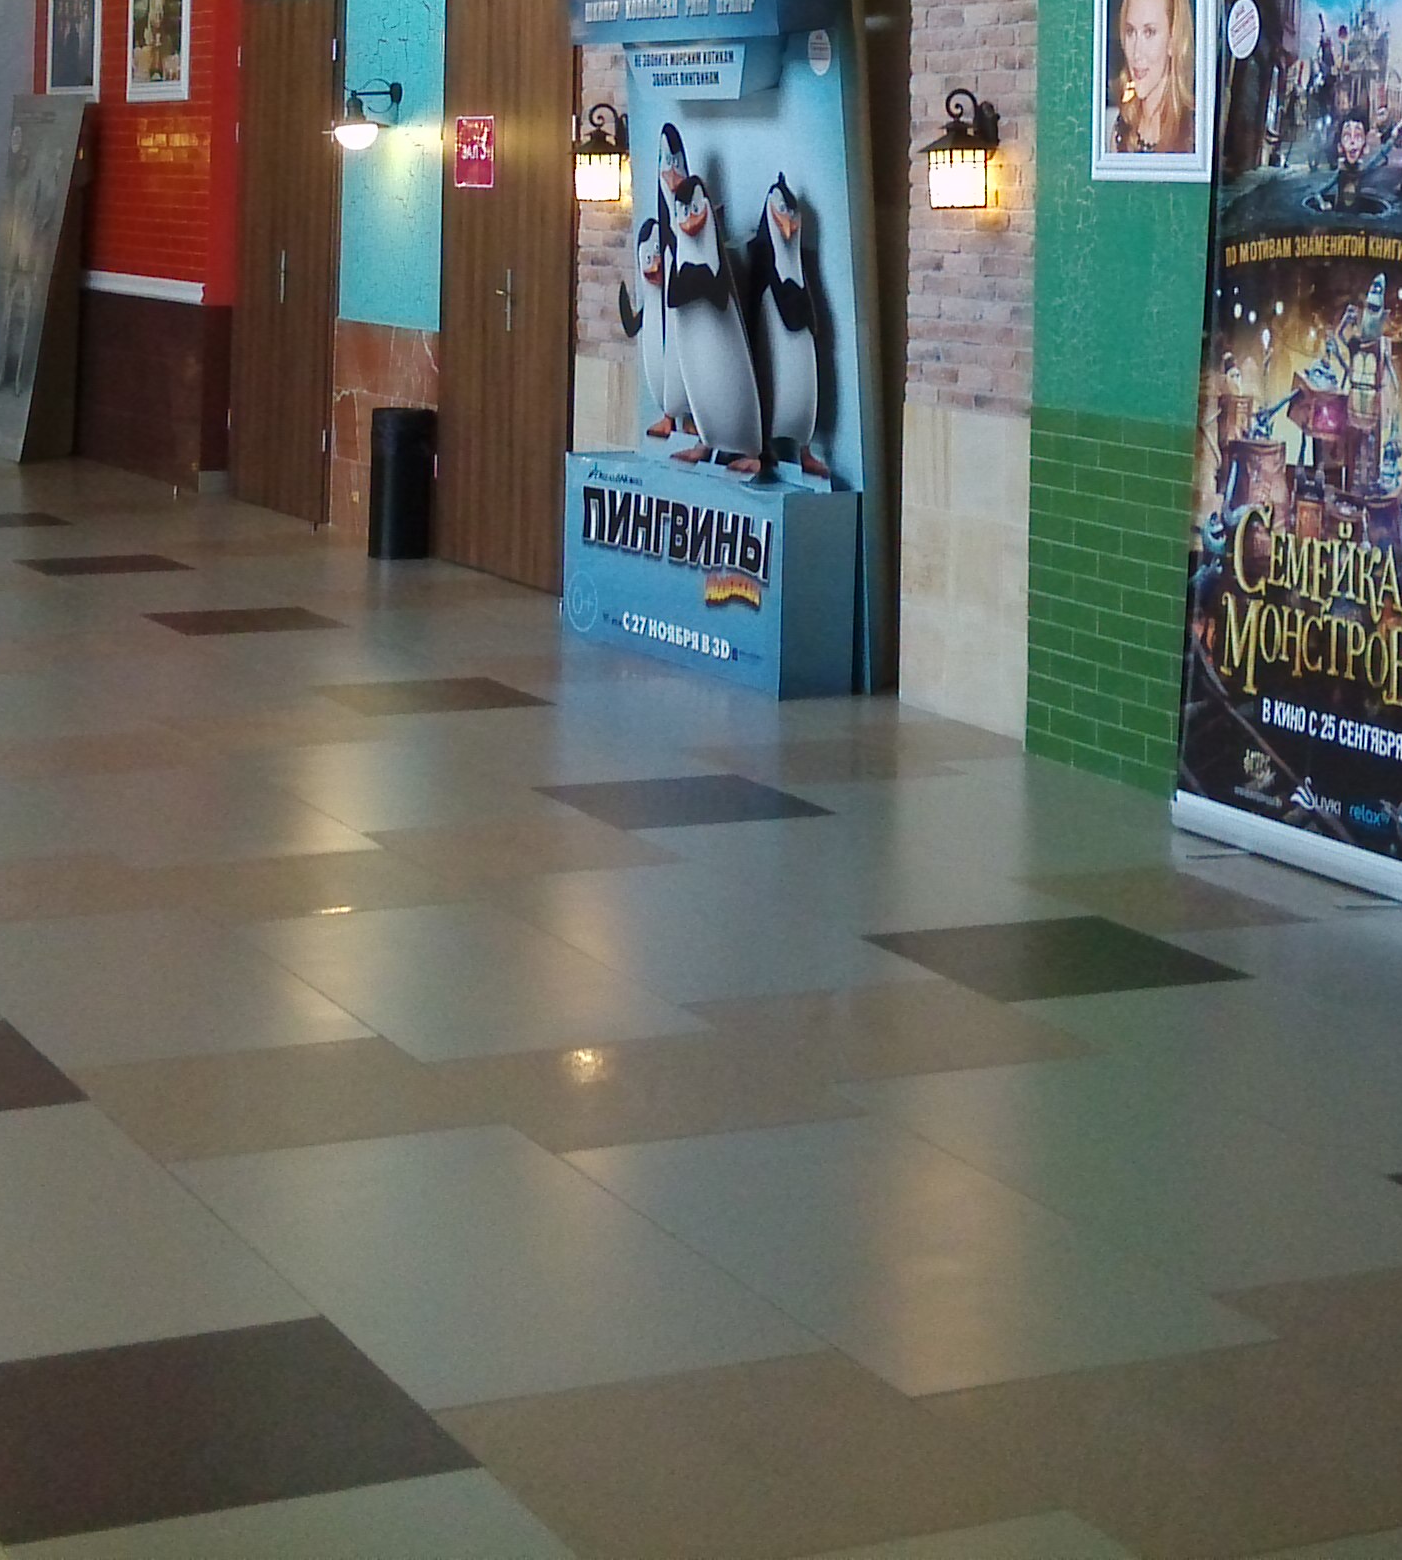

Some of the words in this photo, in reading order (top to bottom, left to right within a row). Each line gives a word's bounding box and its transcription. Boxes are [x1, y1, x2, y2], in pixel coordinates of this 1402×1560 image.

[1225, 243, 1237, 268] ПО
[1239, 233, 1292, 264] МОТИВАМ
[1295, 230, 1366, 257] ЗНАМЕНИТОЙ
[582, 485, 772, 582] ПИНГВИНЫ
[623, 611, 630, 630] С
[632, 616, 647, 635] 27
[648, 619, 699, 650] НОЯБРЯ
[701, 632, 710, 655] В
[712, 638, 730, 660] 3D
[1262, 696, 1272, 724] В
[1273, 701, 1306, 735] КИНО
[1308, 711, 1318, 738] С
[1320, 713, 1336, 742] 25
